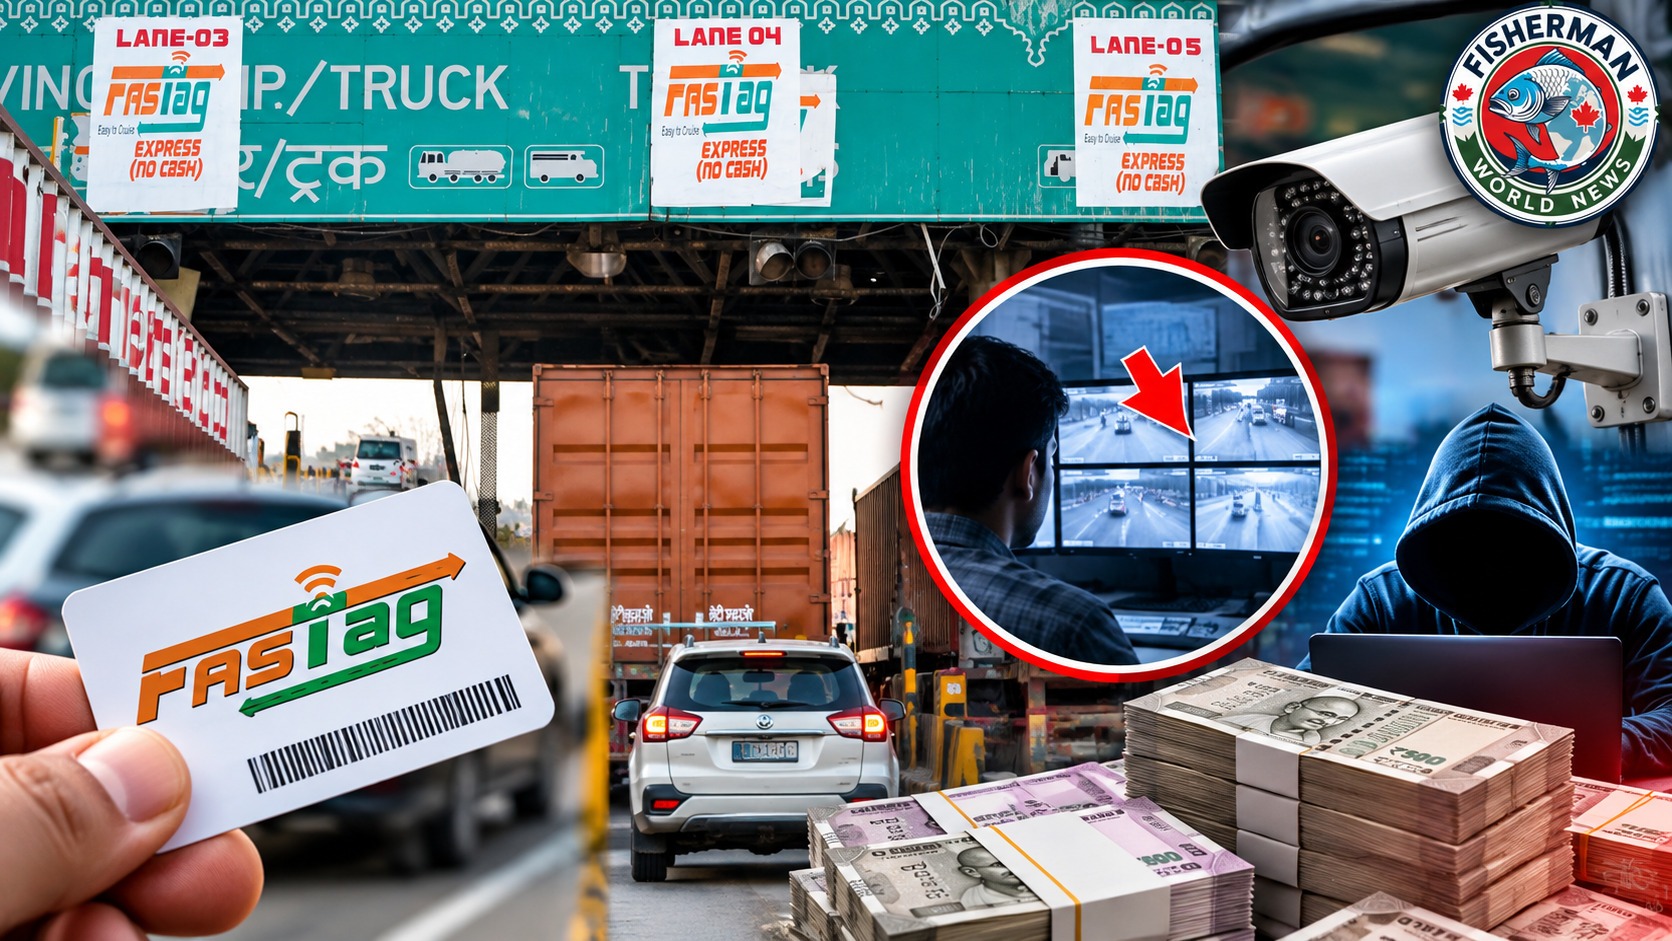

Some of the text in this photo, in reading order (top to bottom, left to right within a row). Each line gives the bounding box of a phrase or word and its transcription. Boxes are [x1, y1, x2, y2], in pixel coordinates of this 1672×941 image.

[116, 29, 229, 47] LANE-03
[674, 27, 782, 46] LANE 04
[134, 139, 202, 158] EXPRESS
[701, 139, 767, 158] EXPRESS
[129, 159, 157, 182] (NO
[1121, 152, 1185, 171] EXPRESS
[696, 160, 723, 183] (NO
[1116, 171, 1142, 193] (NO
